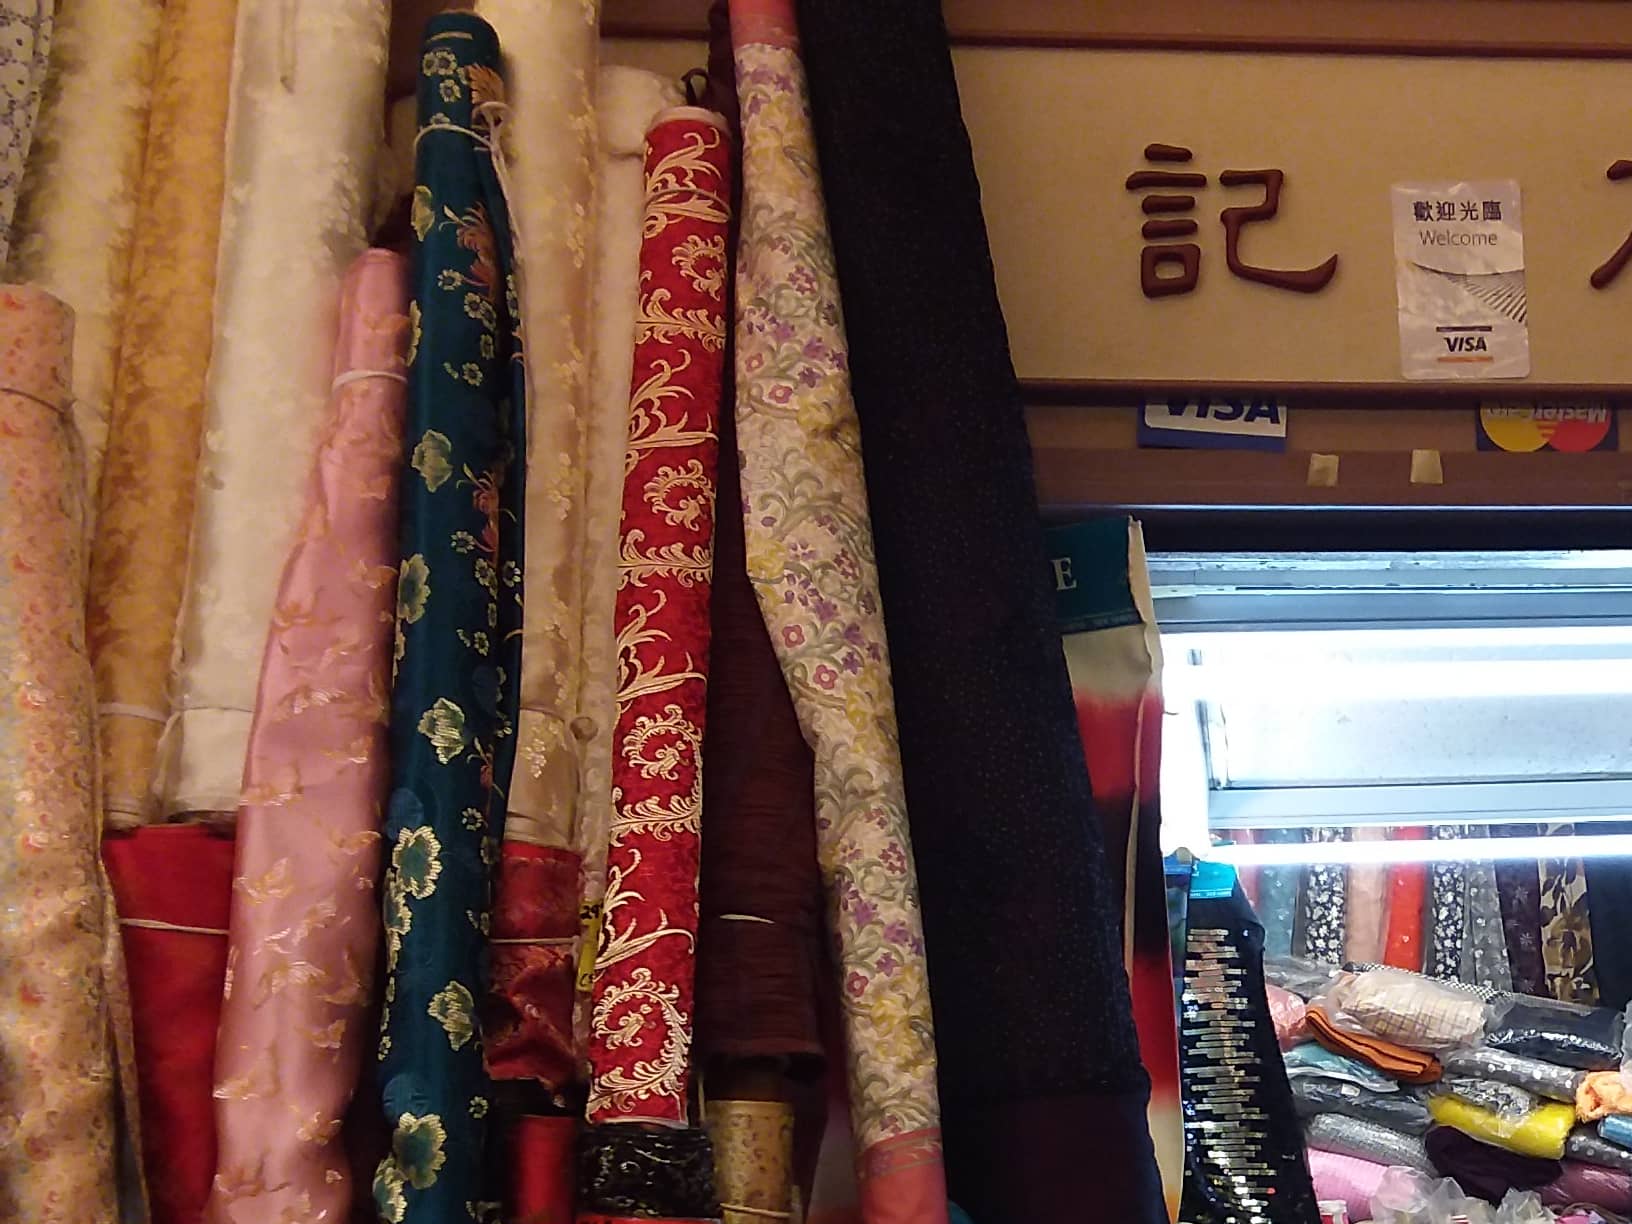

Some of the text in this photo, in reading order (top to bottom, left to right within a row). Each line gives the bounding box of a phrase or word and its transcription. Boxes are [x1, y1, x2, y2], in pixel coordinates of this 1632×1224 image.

[1414, 201, 1502, 221] 歡迎光臨
[1420, 230, 1498, 246] Welcome
[1444, 336, 1487, 352] VISA
